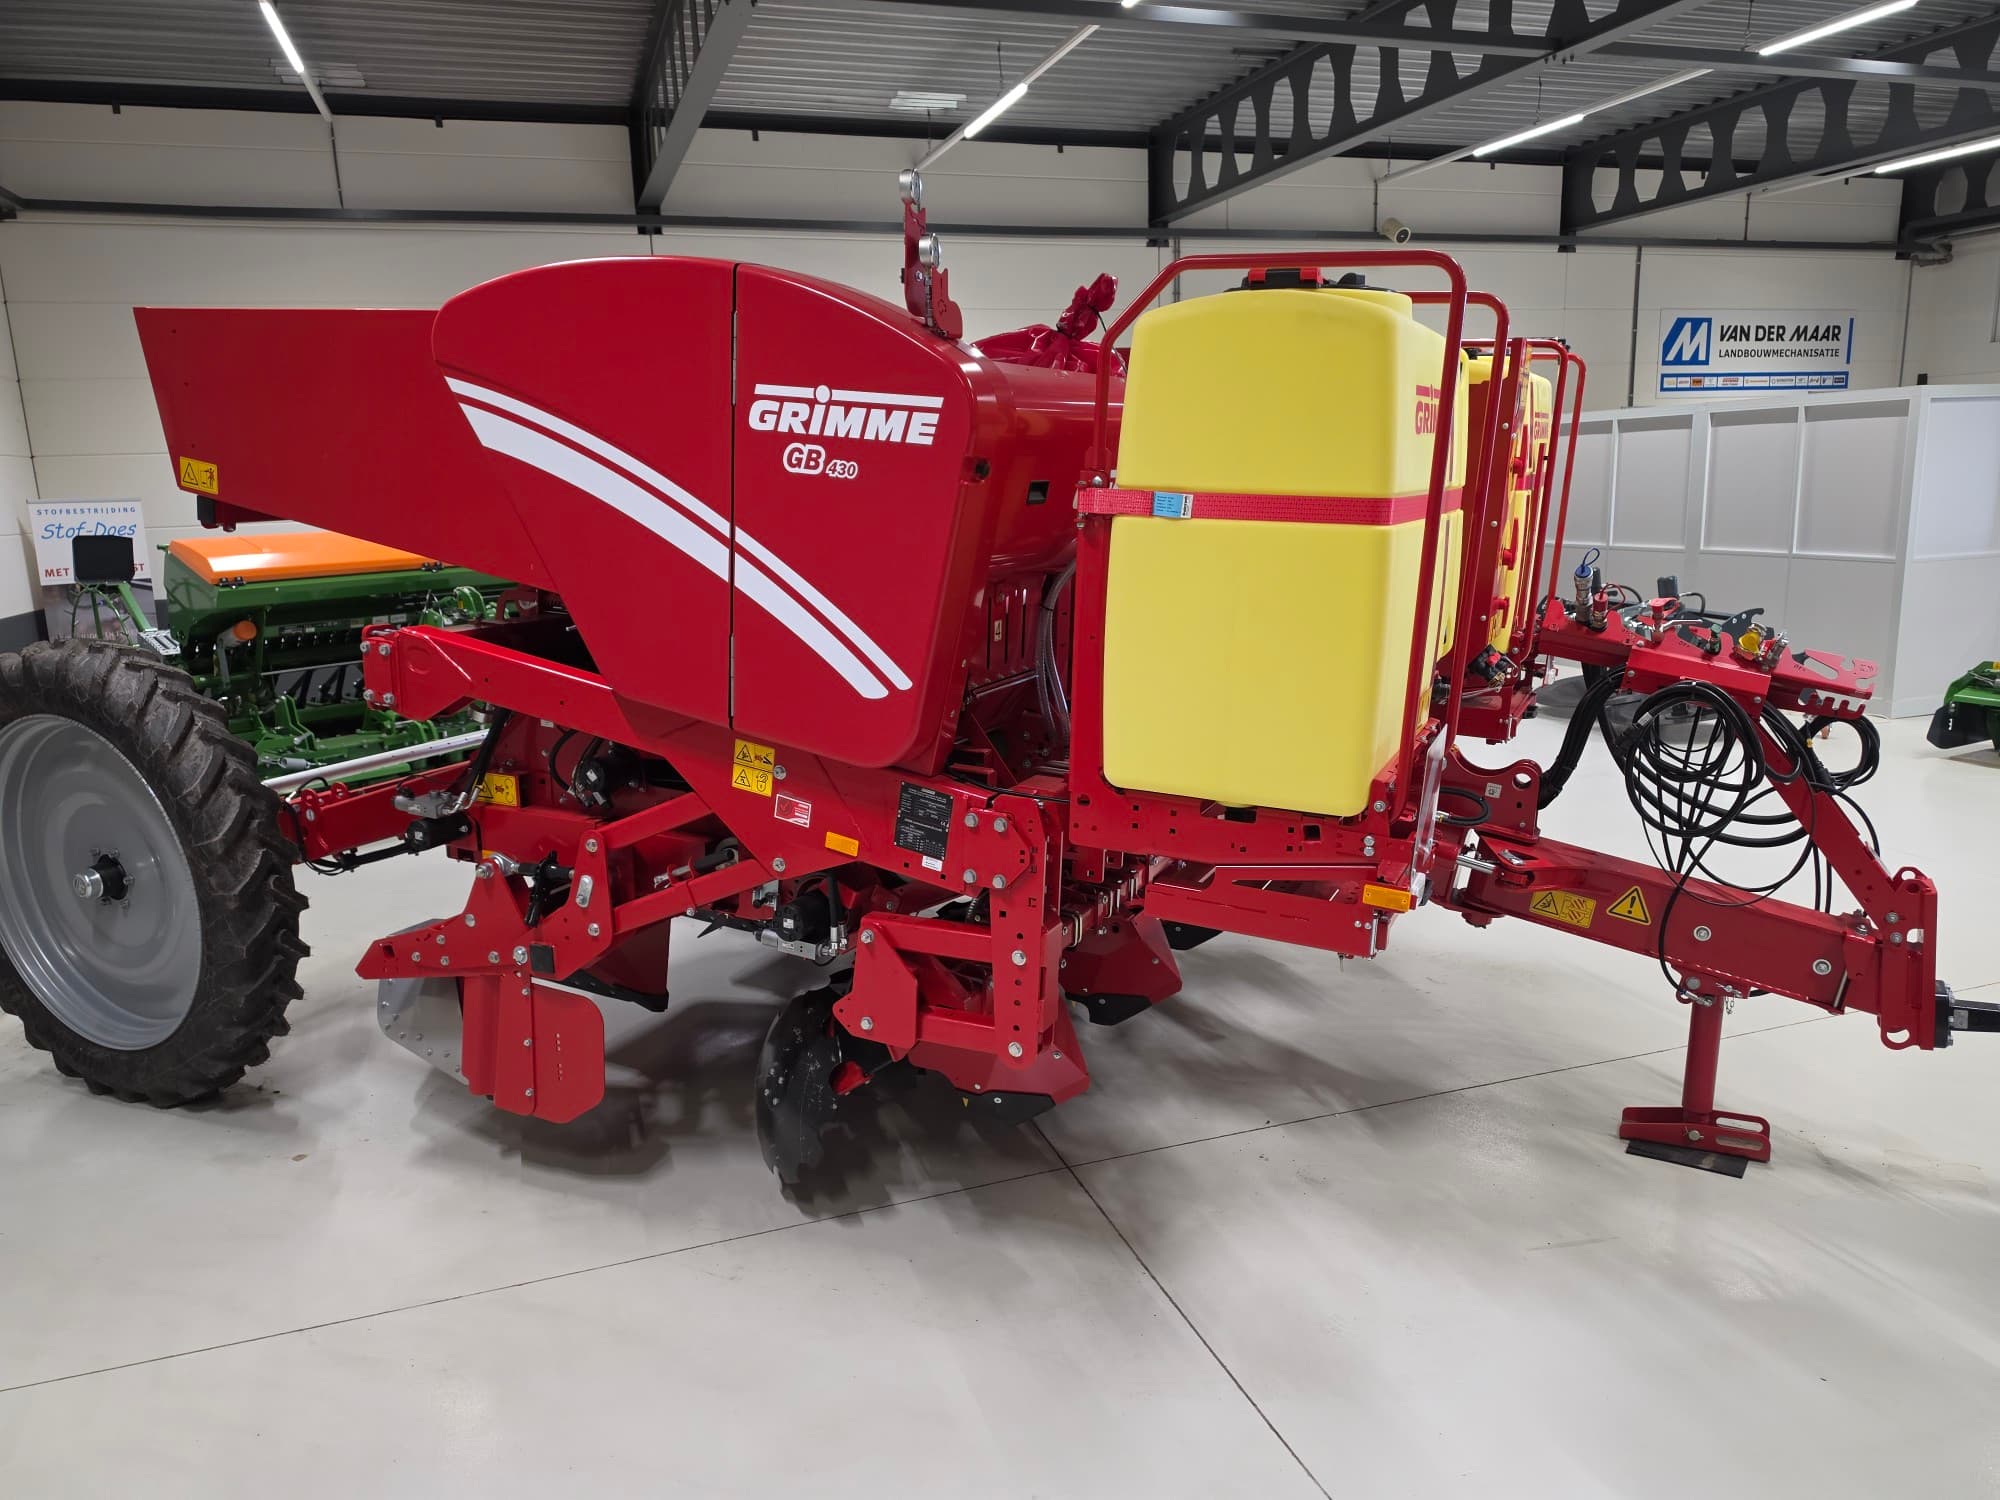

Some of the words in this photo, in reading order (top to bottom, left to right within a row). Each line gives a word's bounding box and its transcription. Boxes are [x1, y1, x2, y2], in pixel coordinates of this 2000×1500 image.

[1719, 325, 1752, 342] VAN
[1754, 325, 1786, 342] DER
[1788, 324, 1842, 342] MAAR
[1718, 348, 1840, 358] LANDBOUWMECHANISATIE
[748, 385, 941, 446] GRIMME
[785, 444, 824, 474] GB
[827, 460, 857, 479] 430
[36, 507, 136, 516] STOFBESTRIJDING
[41, 521, 137, 540] Stof-Does
[44, 567, 70, 578] MET
